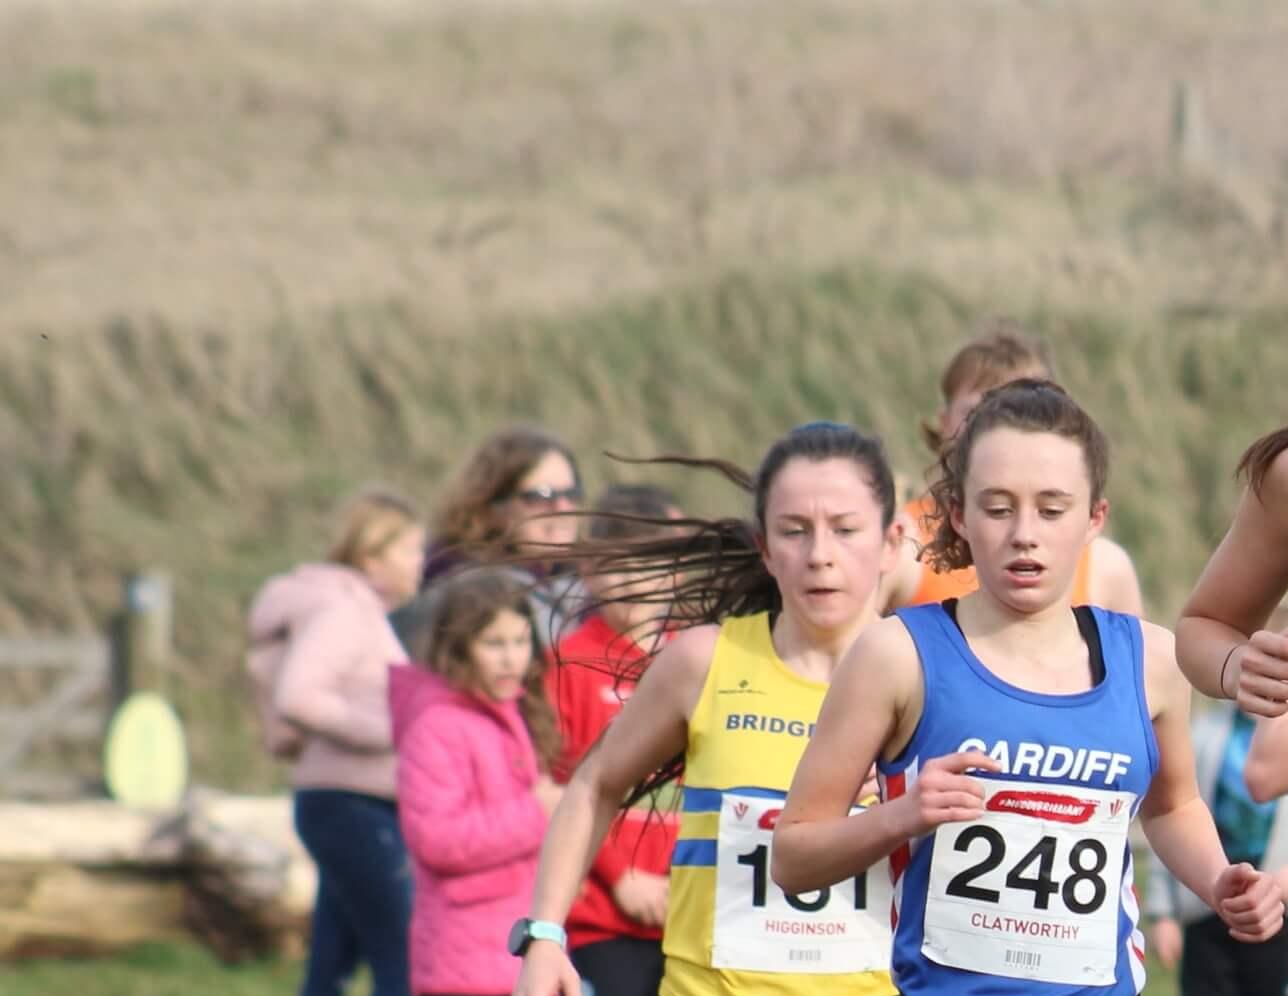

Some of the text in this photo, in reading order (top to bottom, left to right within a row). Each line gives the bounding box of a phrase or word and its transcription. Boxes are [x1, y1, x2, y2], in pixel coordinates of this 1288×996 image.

[945, 824, 1108, 915] 248
[765, 920, 846, 934] HIGGINSON
[970, 913, 1080, 940] CLATWORTHY
